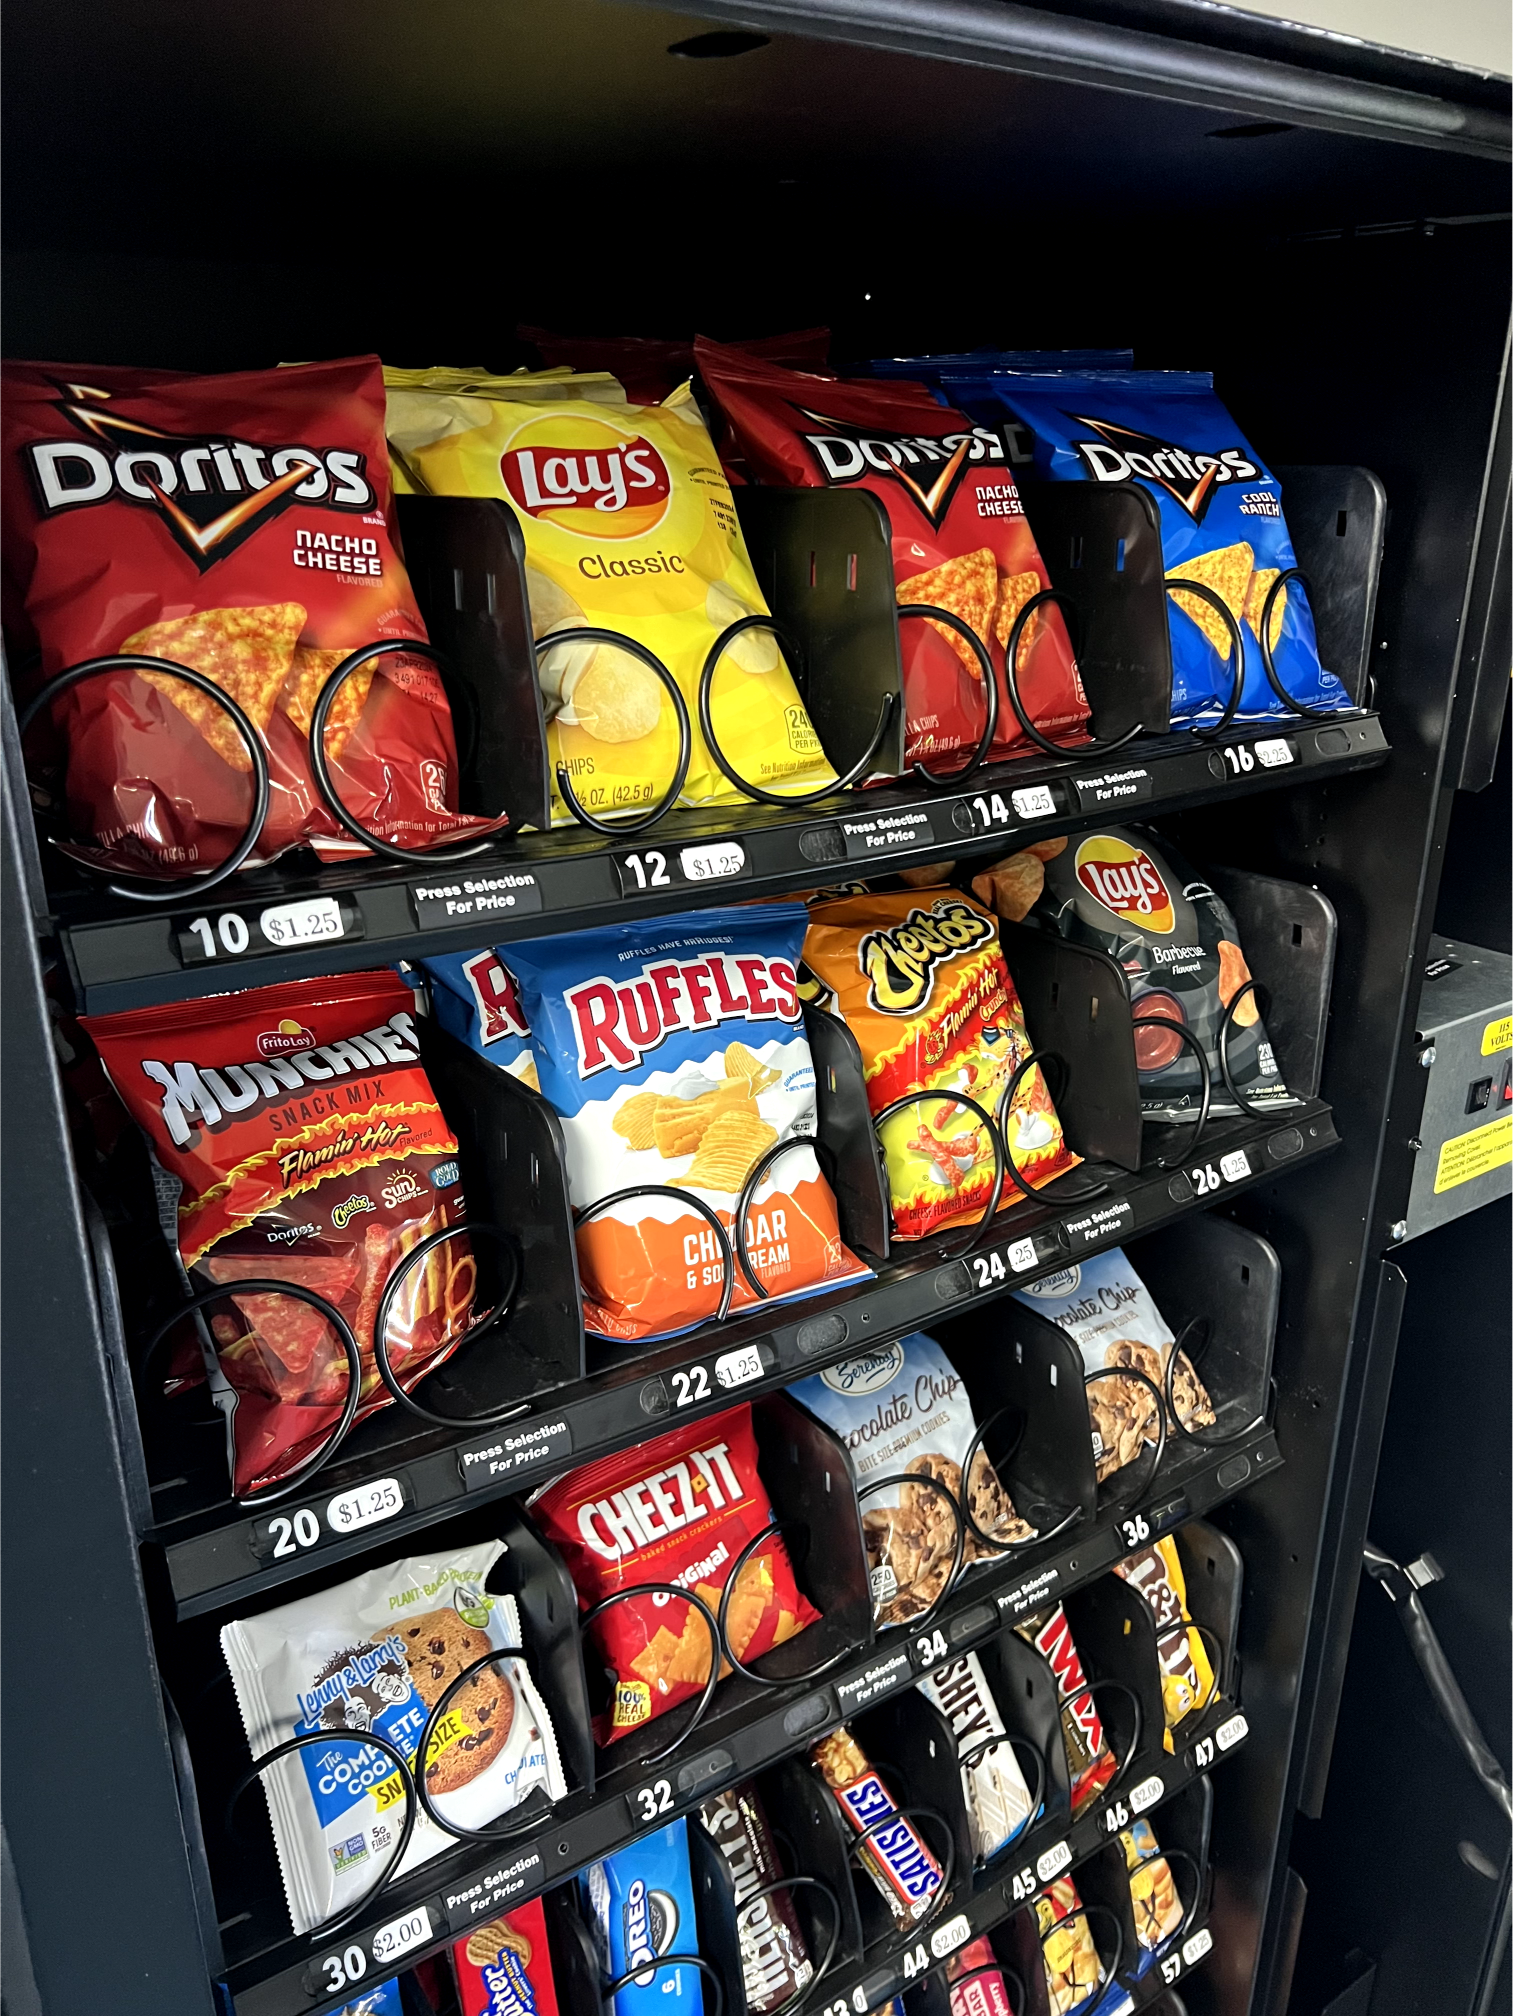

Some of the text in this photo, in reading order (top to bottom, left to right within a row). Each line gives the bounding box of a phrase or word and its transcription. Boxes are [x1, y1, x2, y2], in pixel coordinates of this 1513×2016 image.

[806, 427, 1004, 480] Doritos
[1078, 443, 1258, 482] Doritos
[32, 442, 372, 509] Doritos
[515, 442, 658, 513] Lay's
[975, 485, 1019, 500] NACHO
[1241, 492, 1277, 503] COOL
[977, 501, 1025, 516] CHEESE
[1239, 503, 1280, 517] RANCH
[296, 530, 377, 556] NACHO
[293, 549, 382, 576] CHEESE
[578, 550, 686, 580] Classic
[336, 574, 384, 588] FLAVORED
[921, 714, 940, 731] CHIPS
[760, 763, 771, 775] See
[1224, 745, 1254, 774] 16
[590, 782, 654, 806] OZ. (42.5 g)
[1077, 769, 1148, 791] Press Selection
[1096, 784, 1137, 801] For Price
[844, 812, 928, 836] Press Selection
[972, 794, 1010, 828] 14
[425, 821, 436, 833] for
[865, 830, 916, 848] For Price
[624, 851, 742, 889] 12 $1.25
[1085, 857, 1160, 914] Lay's
[415, 873, 536, 902] Press Selection
[446, 894, 516, 916] For Price
[189, 912, 338, 957] 10 $1.25
[617, 946, 657, 962] RUFFLES
[658, 940, 682, 951] HAVE
[866, 906, 986, 1010] Cheetos
[1152, 944, 1207, 964] Barbecue
[978, 966, 999, 998] Hot
[1172, 962, 1202, 976] Flavored
[570, 955, 802, 1072] RUFFLES
[268, 1079, 386, 1132] SNACK MIX
[400, 1128, 433, 1147] Flavored
[279, 1120, 412, 1189] Flamin' Hot
[381, 1180, 413, 1209] Sun
[1193, 1164, 1221, 1196] 26
[333, 1196, 369, 1227] Cheetos
[397, 1190, 418, 1205] CHIPS
[934, 1197, 962, 1218] FLAVORED
[962, 1189, 982, 1205] SNACKS
[267, 1221, 315, 1244] Doritos
[1067, 1201, 1131, 1235] Press Selection
[1084, 1219, 1122, 1241] For Price
[687, 1270, 698, 1290] &
[760, 1261, 793, 1280] FLAVORED
[973, 1255, 1007, 1288] 24
[1097, 1281, 1142, 1312] Chip
[671, 1355, 759, 1408] 22 $1.25
[914, 1368, 962, 1413] Chip
[463, 1421, 567, 1467] Press Selection
[857, 1455, 879, 1473] BITE
[878, 1446, 895, 1463] SIZE
[922, 1411, 951, 1436] COOKIES
[489, 1444, 550, 1475] For Price
[268, 1486, 397, 1559] 20 $1.25
[1122, 1513, 1150, 1547] 36
[641, 1516, 723, 1562] baked snack crackers
[871, 1569, 892, 1586] 250
[997, 1568, 1059, 1609] Press Selection
[1013, 1586, 1050, 1613] For Price
[916, 1629, 949, 1667] 34
[296, 1634, 408, 1728] Lenny & Larry's
[837, 1653, 907, 1698] Press Selection
[856, 1673, 897, 1702] For Price
[617, 1711, 646, 1723] CHEESE
[618, 1702, 645, 1715] REAL
[429, 1715, 462, 1755] SIZE
[1194, 1718, 1245, 1767] 47 $2.00
[316, 1749, 343, 1772] The
[636, 1778, 675, 1821] 32
[1104, 1781, 1162, 1833] 46 $2.00
[371, 1832, 392, 1850] FIBER
[743, 1814, 766, 1874] milk chocolate
[446, 1853, 540, 1910] Press Selection
[1011, 1846, 1068, 1900] 45 $2.00
[469, 1878, 525, 1914] For Price
[627, 1878, 657, 1989] OREO
[321, 1916, 423, 1993] 30 $2.00
[903, 1924, 967, 1979] 44 $2.00
[501, 1950, 527, 2002] PEANUT BUTTER
[1160, 1952, 1182, 1985] 57
[661, 1978, 676, 1994] 6
